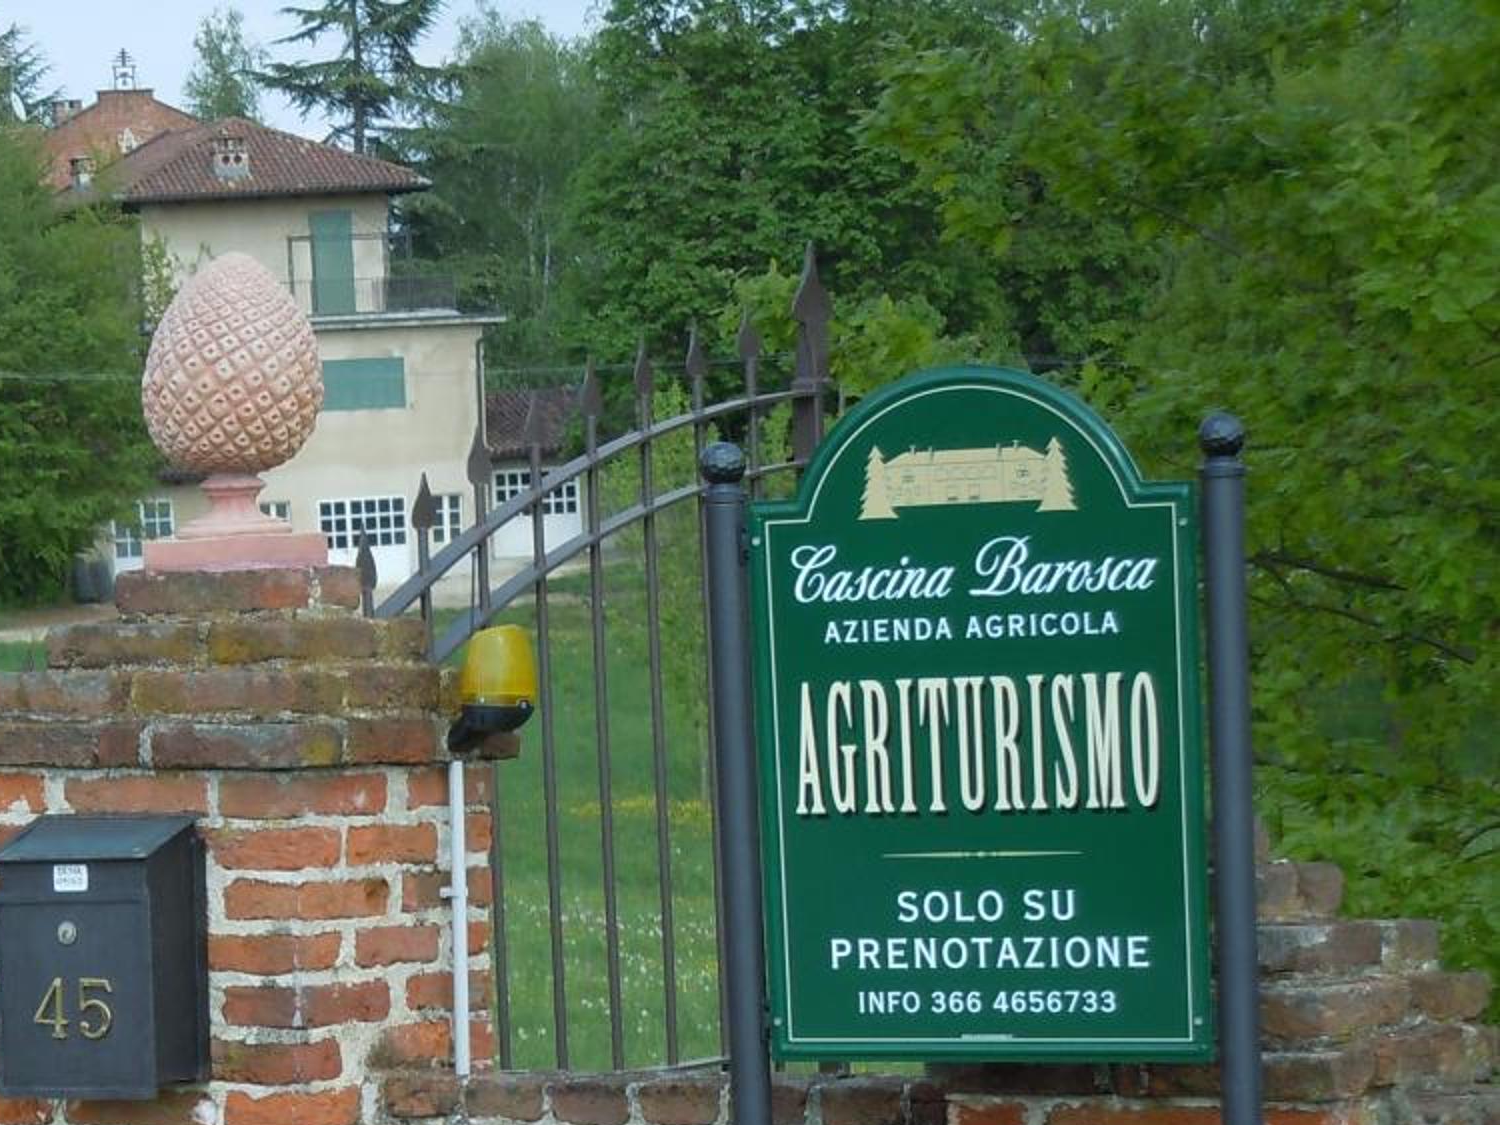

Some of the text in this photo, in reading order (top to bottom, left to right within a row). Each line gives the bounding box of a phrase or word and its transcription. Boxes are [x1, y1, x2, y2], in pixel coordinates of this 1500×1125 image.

[790, 536, 1158, 603] Cascina Barosca
[824, 611, 1119, 644] AZIENDA AGRICOLA
[795, 671, 1160, 815] AGRITURISMO
[897, 889, 1075, 923] SOLO SU
[830, 935, 1151, 970] PRENOTAZIONE
[33, 976, 113, 1040] 45
[858, 990, 1117, 1014] INFO 366 4656733
